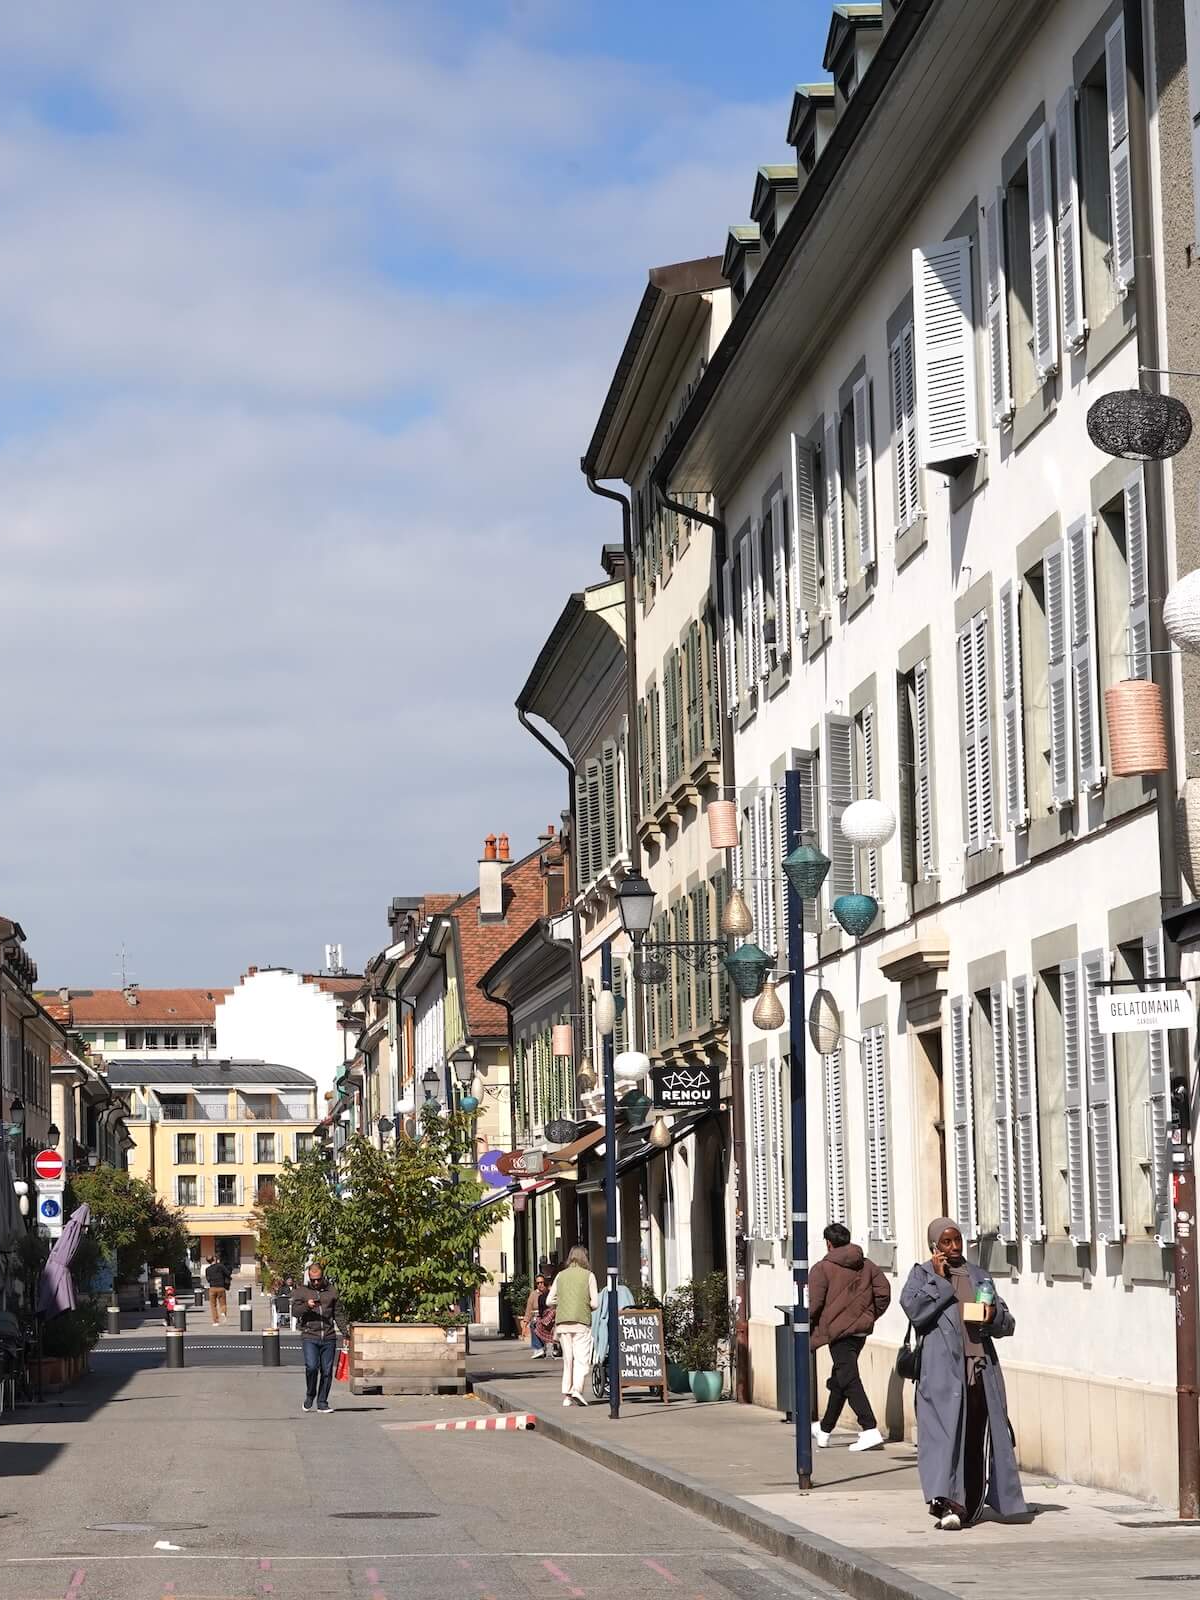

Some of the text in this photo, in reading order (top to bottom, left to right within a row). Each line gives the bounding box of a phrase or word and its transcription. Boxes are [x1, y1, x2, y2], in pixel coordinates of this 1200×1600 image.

[1110, 999, 1180, 1017] GELATOMANIA
[662, 1090, 711, 1100] RENOU
[623, 1326, 654, 1340] PAINS
[625, 1354, 657, 1367] MAISON
